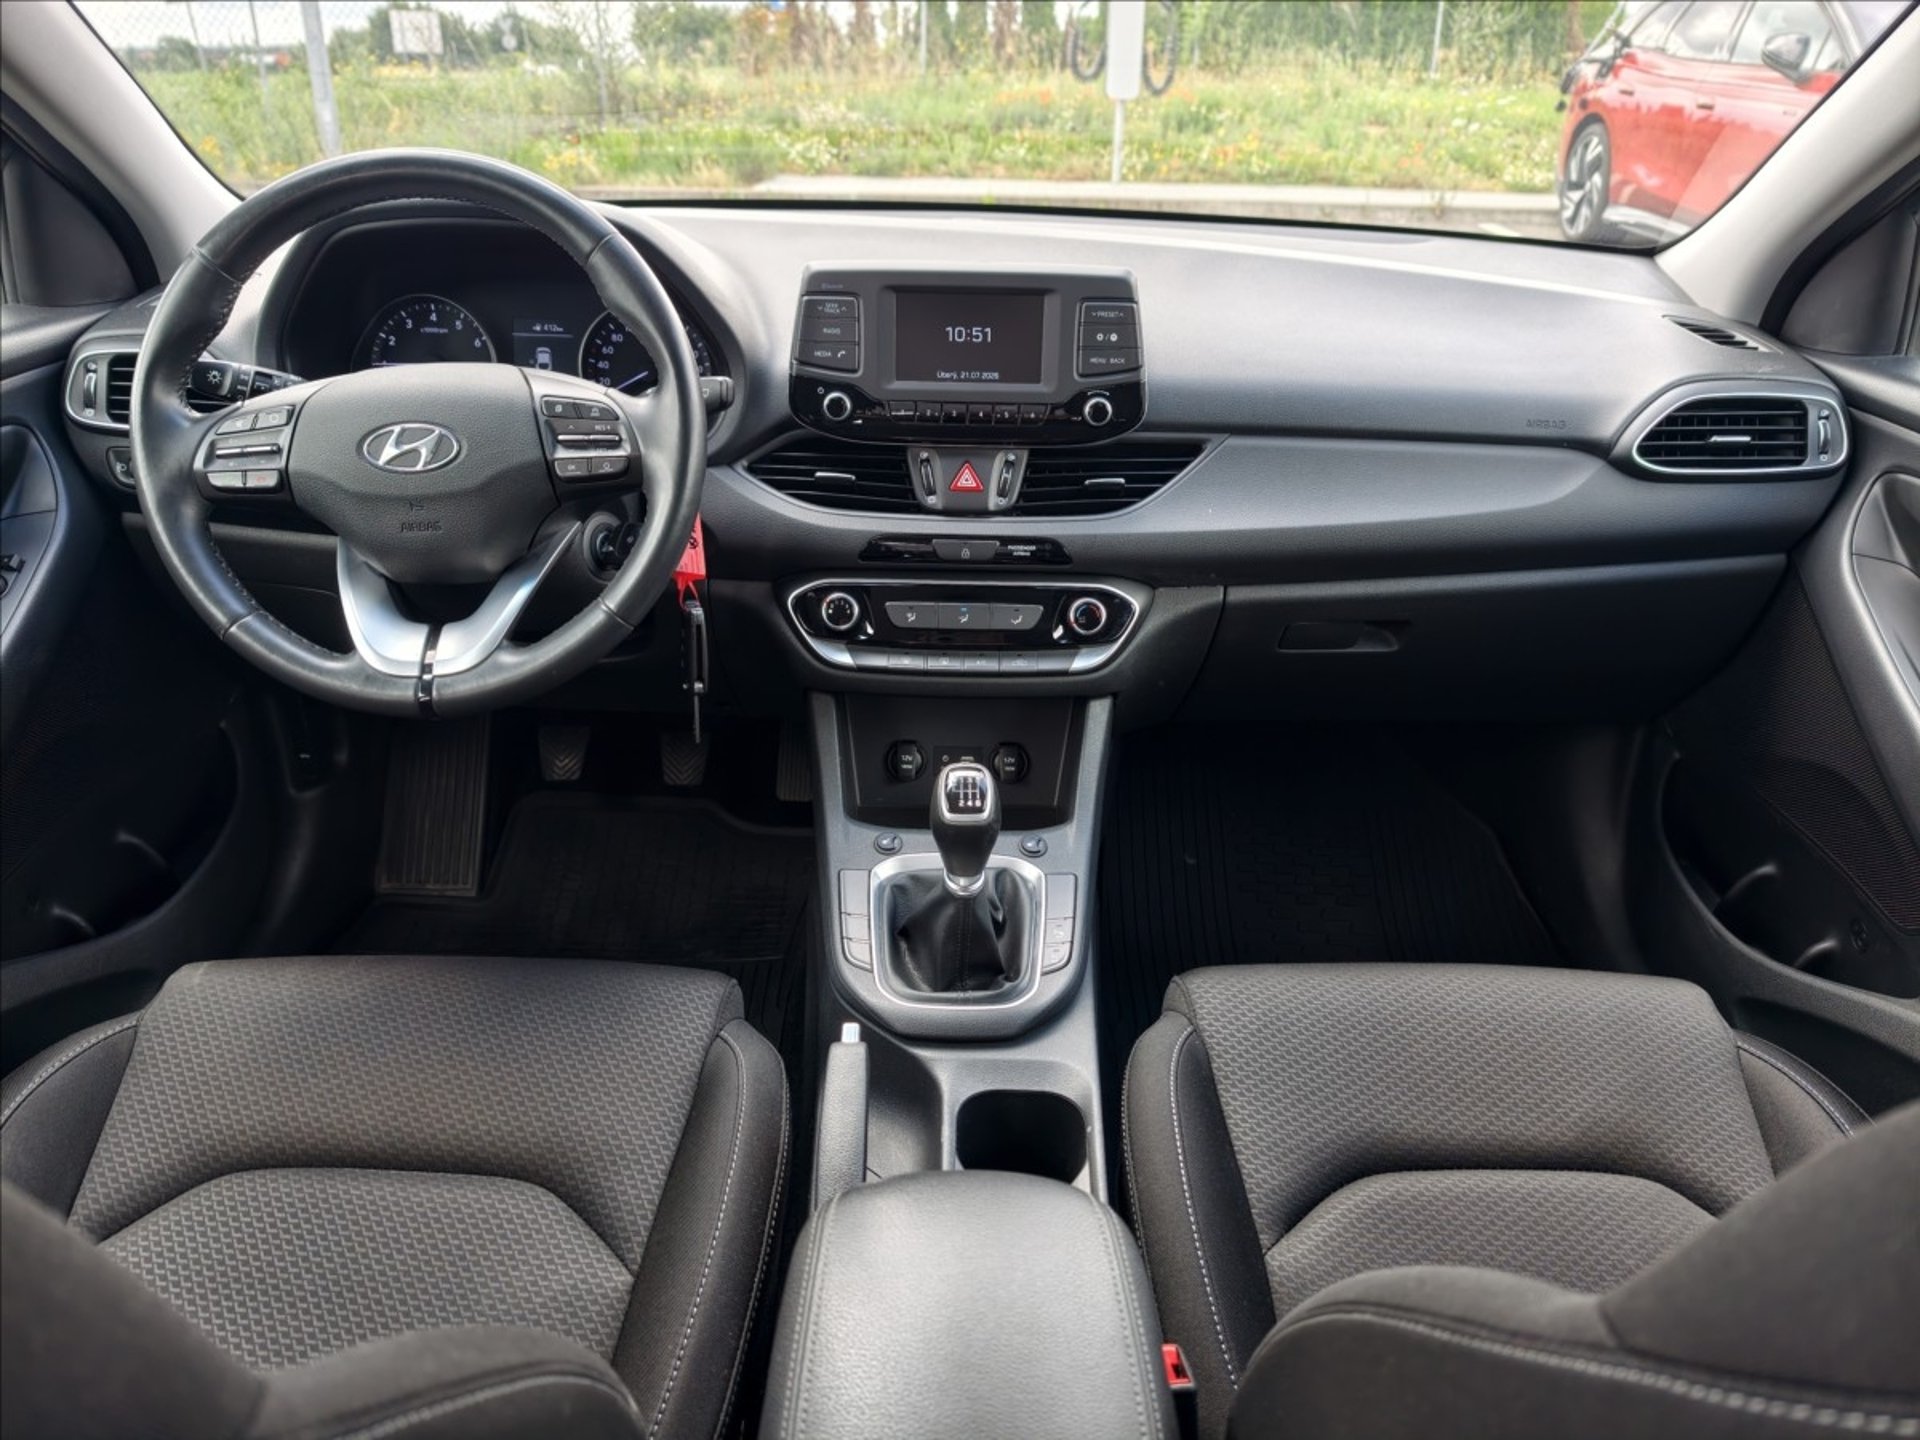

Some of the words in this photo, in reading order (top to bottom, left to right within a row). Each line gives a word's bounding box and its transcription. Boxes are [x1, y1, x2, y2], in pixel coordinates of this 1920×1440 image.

[430, 312, 438, 321] 4
[1096, 310, 1119, 318] PRESET
[406, 319, 413, 329] 3
[455, 320, 462, 330] 5
[610, 333, 624, 343] 80
[945, 326, 992, 343] 10:51
[388, 336, 396, 346] 2
[474, 338, 482, 348] 6
[601, 346, 614, 355] 60
[596, 361, 610, 369] 40
[401, 520, 442, 532] AIRBAG
[958, 799, 965, 807] 2
[966, 799, 973, 807] 4
